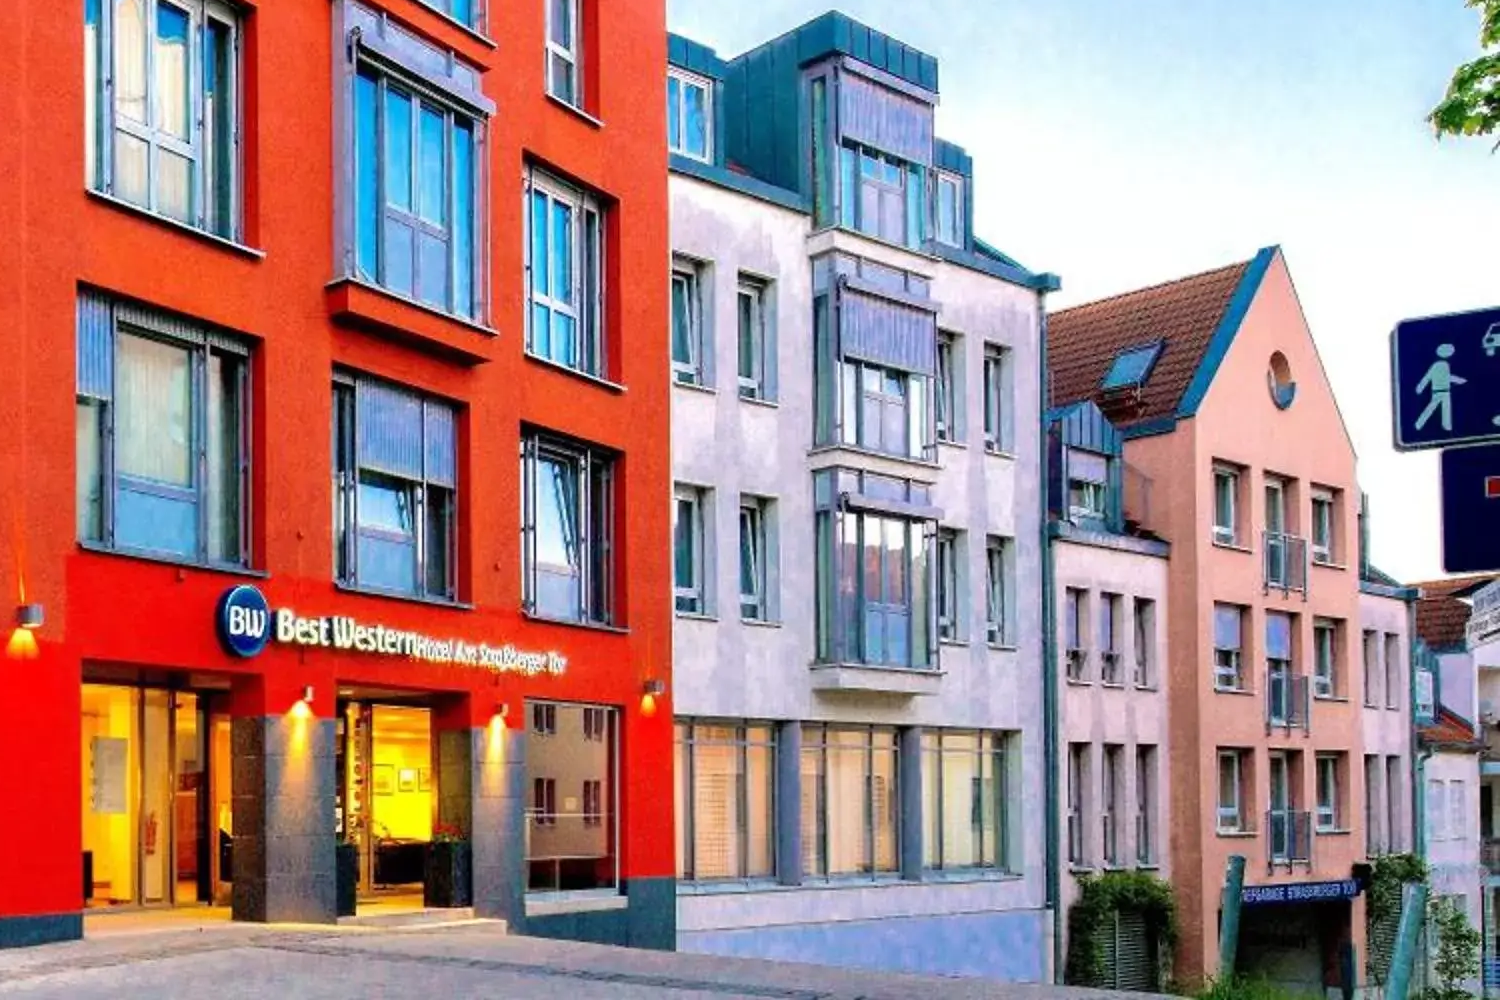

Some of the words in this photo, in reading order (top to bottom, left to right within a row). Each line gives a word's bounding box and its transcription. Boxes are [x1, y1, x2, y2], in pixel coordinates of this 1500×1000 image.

[229, 605, 265, 638] BW
[276, 608, 331, 646] Best
[332, 615, 417, 657] Western
